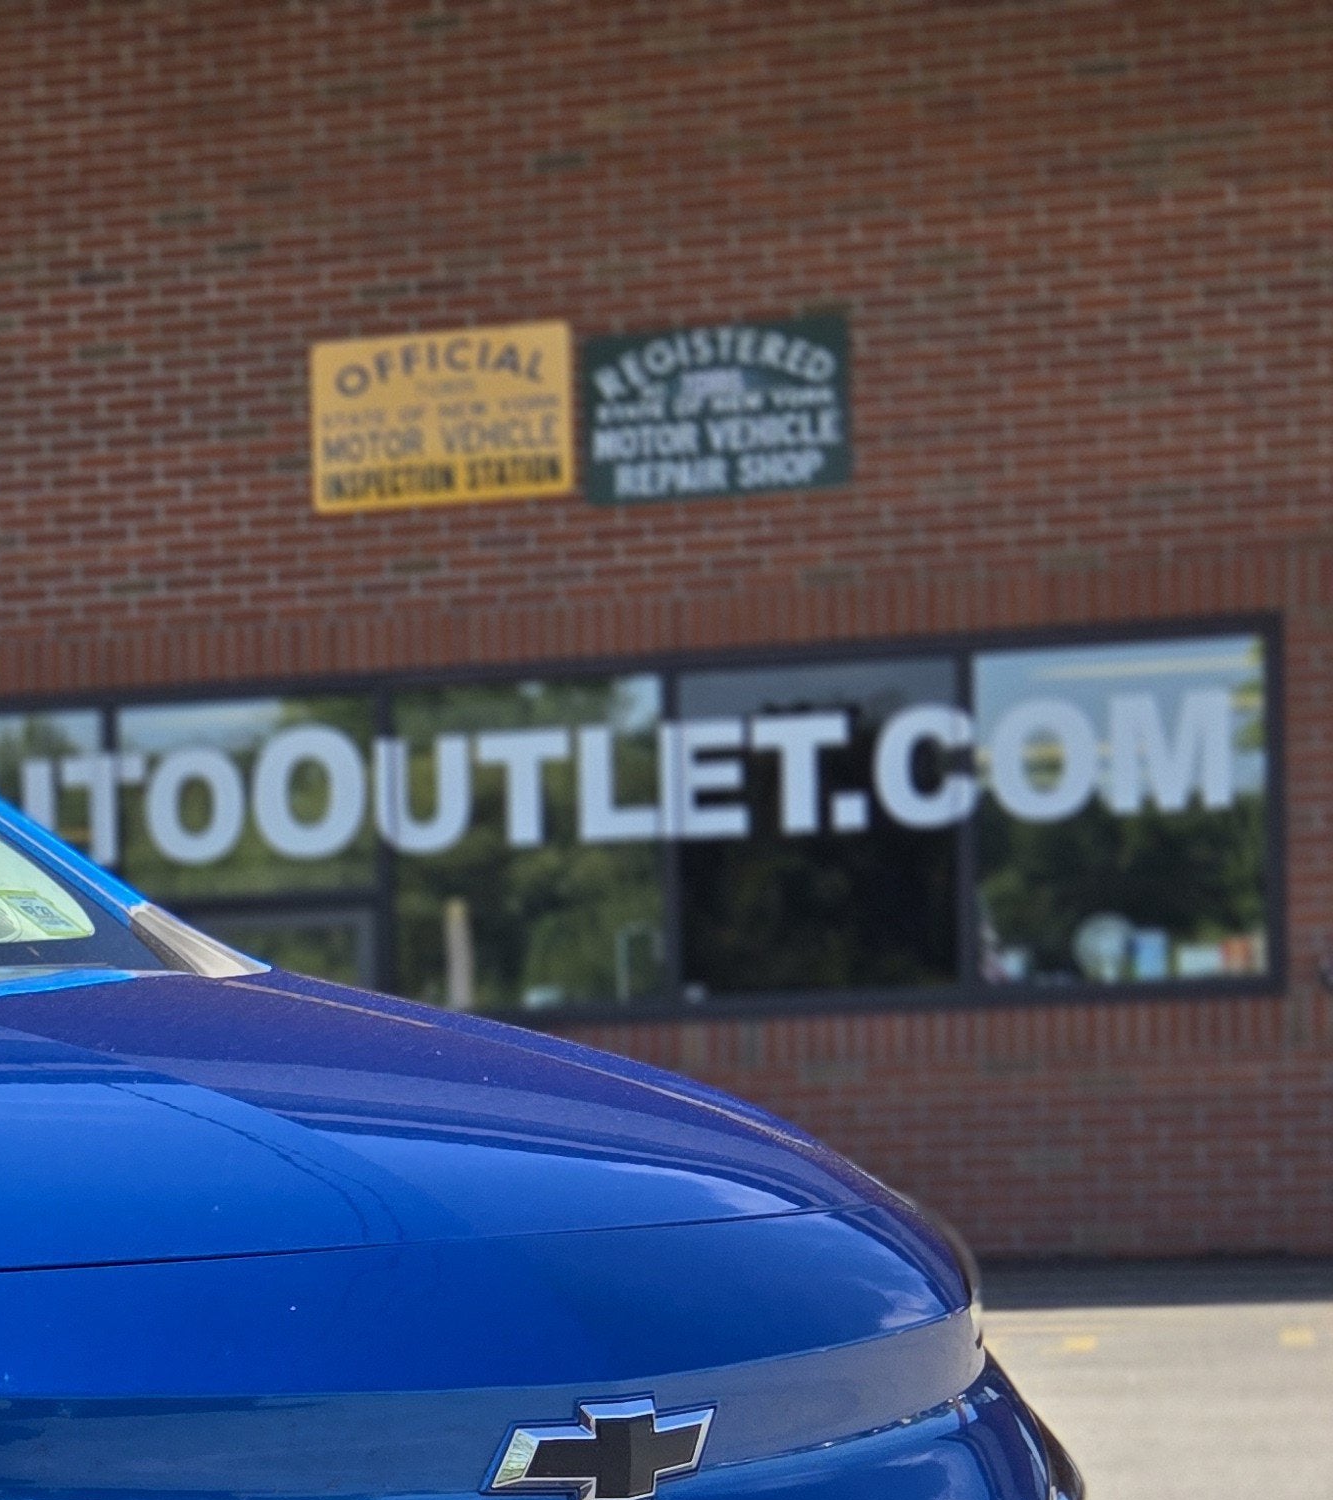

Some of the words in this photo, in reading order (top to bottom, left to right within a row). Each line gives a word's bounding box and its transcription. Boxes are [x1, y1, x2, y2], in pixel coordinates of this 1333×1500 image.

[335, 338, 543, 398] OFFICIAL
[594, 326, 837, 399] REGISTERED
[322, 426, 424, 463] MOTOR
[437, 412, 559, 454] VEHICLE
[593, 421, 700, 462] MOTOR
[704, 408, 841, 450] VEHICLE
[323, 463, 455, 500] INSPECTION
[466, 453, 563, 491] STATION
[615, 457, 730, 497] REPAIR
[738, 449, 826, 489] SHOP
